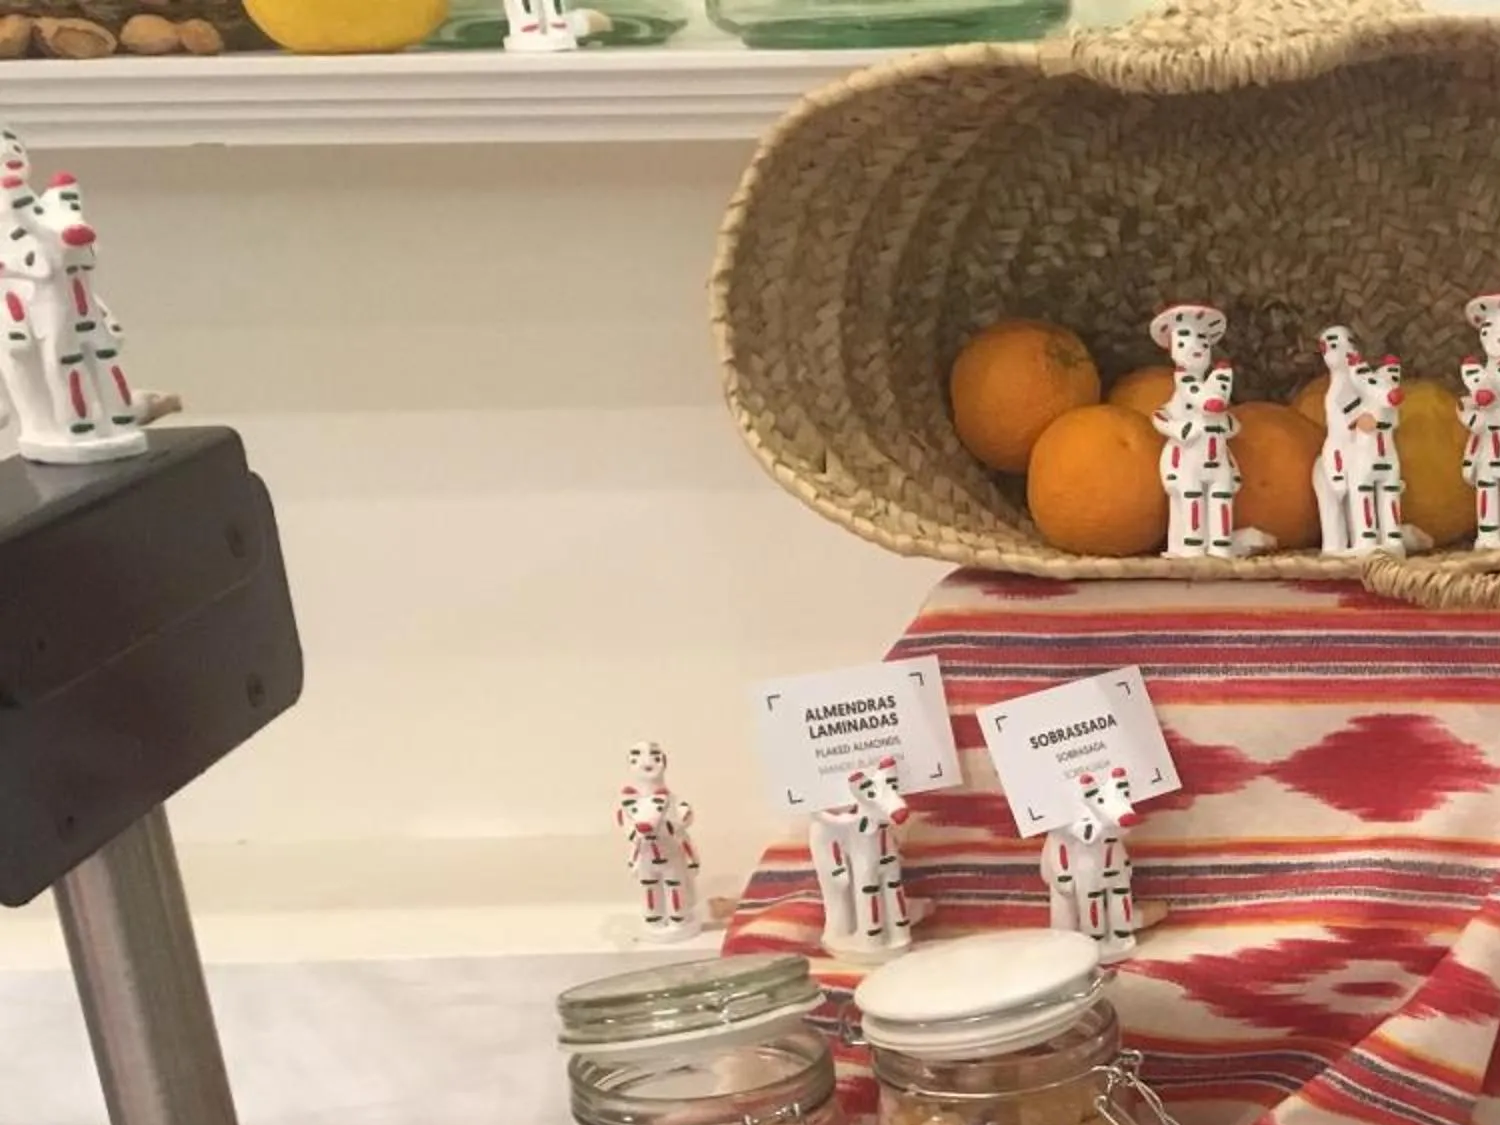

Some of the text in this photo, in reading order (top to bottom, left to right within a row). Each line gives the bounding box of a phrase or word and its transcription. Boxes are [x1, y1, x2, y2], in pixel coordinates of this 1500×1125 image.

[805, 695, 897, 722] ALMENDRAS
[809, 712, 899, 739] LAMINADAS
[1029, 713, 1117, 749] SOBRASSADA
[853, 735, 902, 752] ALMONDS
